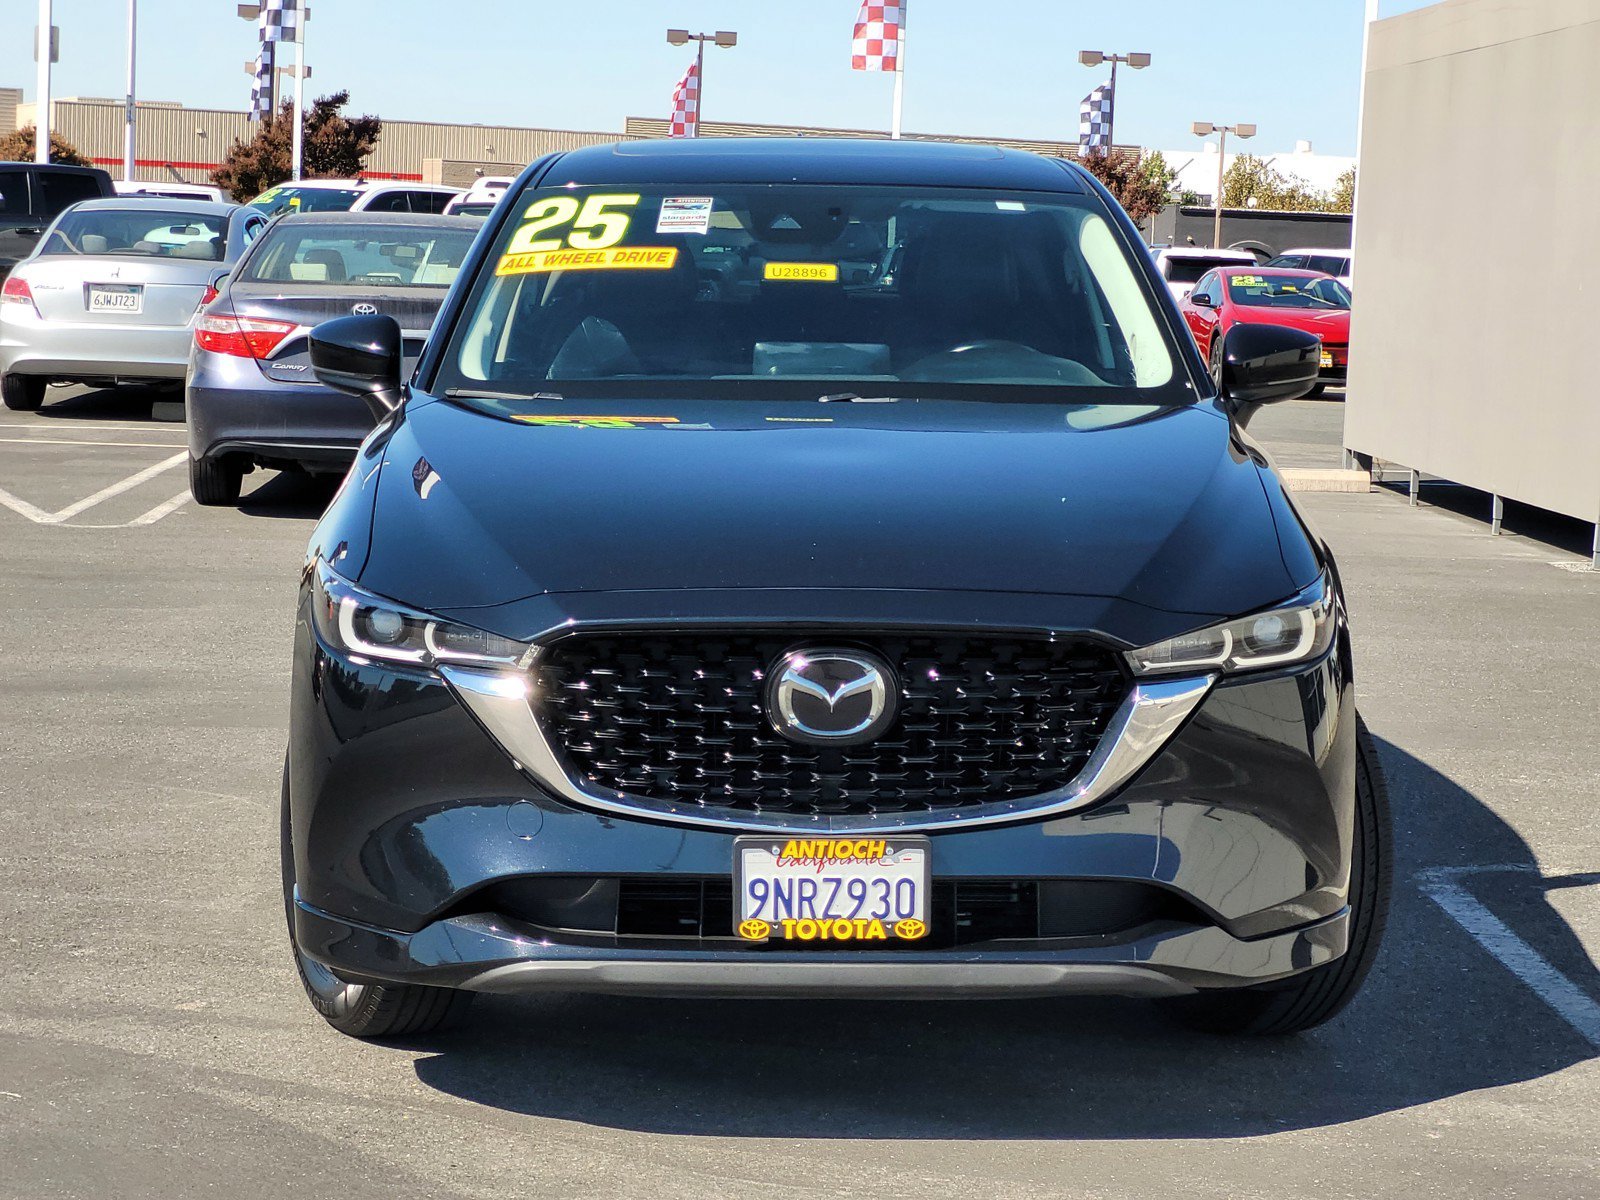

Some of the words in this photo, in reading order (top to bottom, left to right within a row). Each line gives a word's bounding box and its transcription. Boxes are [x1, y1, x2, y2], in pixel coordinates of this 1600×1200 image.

[507, 194, 641, 254] 25
[502, 256, 535, 270] ALL
[543, 252, 606, 266] WHEEL
[612, 251, 670, 264] DRIVE
[772, 267, 827, 278] U28896
[94, 294, 136, 307] 6JWJ723
[272, 363, 308, 372] Camry
[781, 839, 886, 859] ANTIOCH
[749, 877, 916, 920] 9NRZ930
[781, 918, 887, 940] TOYOTA
